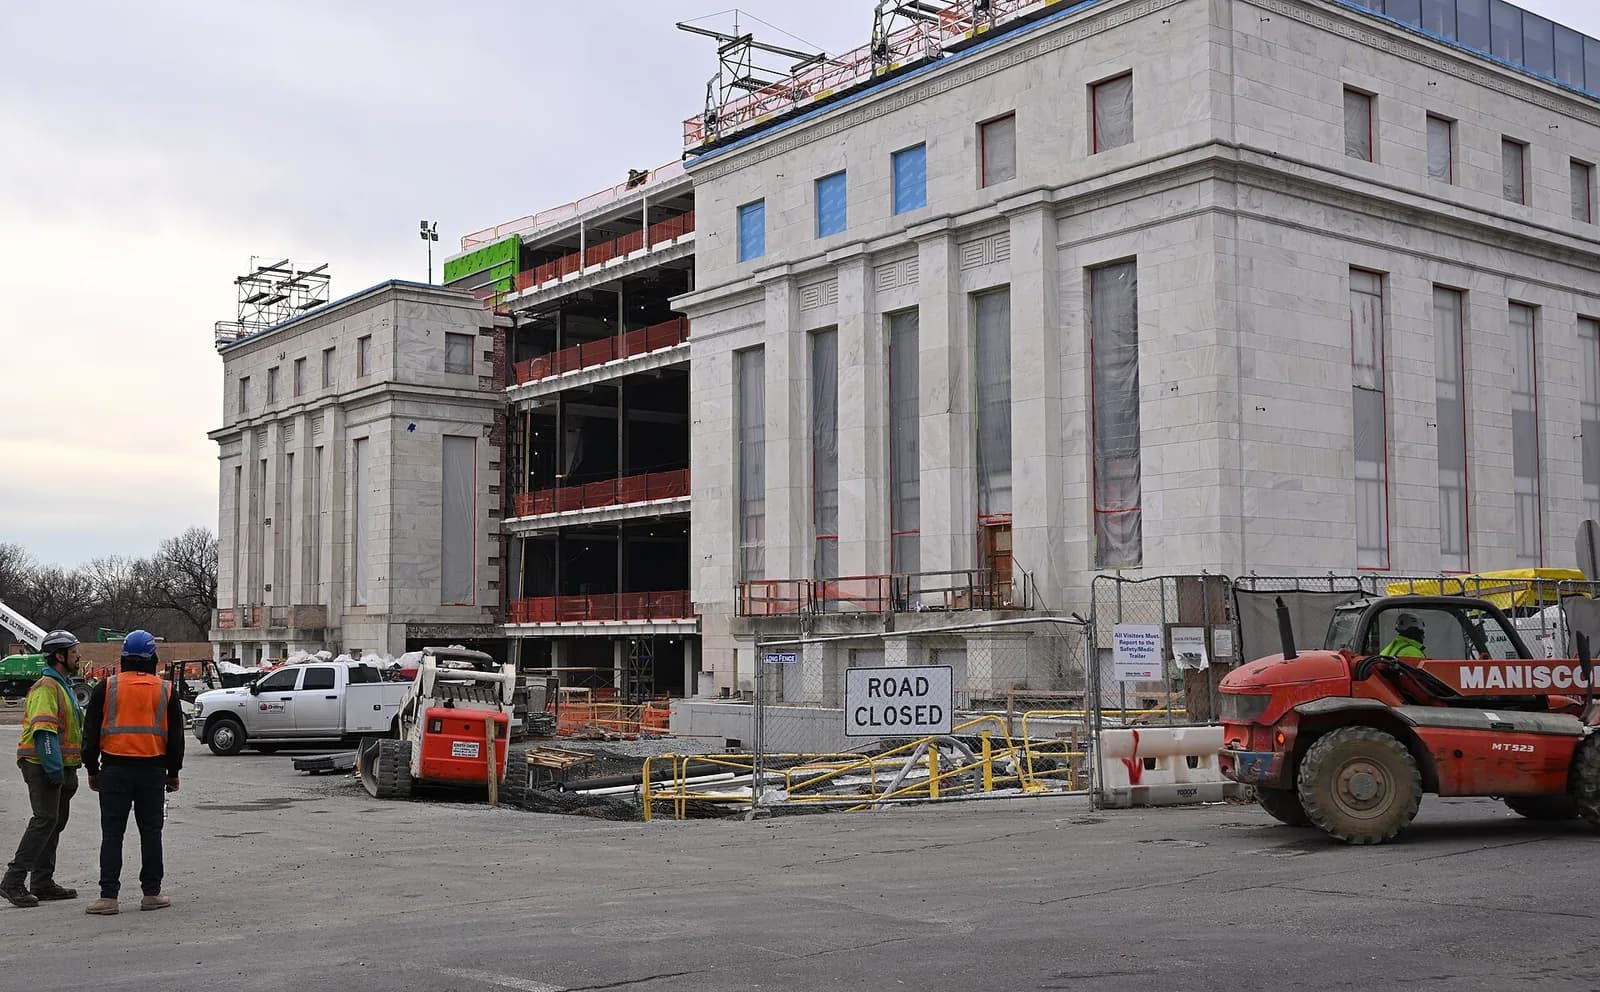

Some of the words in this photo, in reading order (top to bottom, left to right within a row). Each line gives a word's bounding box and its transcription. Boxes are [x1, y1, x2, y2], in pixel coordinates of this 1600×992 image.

[868, 677, 929, 698] ROAD
[855, 705, 943, 726] CLOSED
[1491, 743, 1535, 753] MT523
